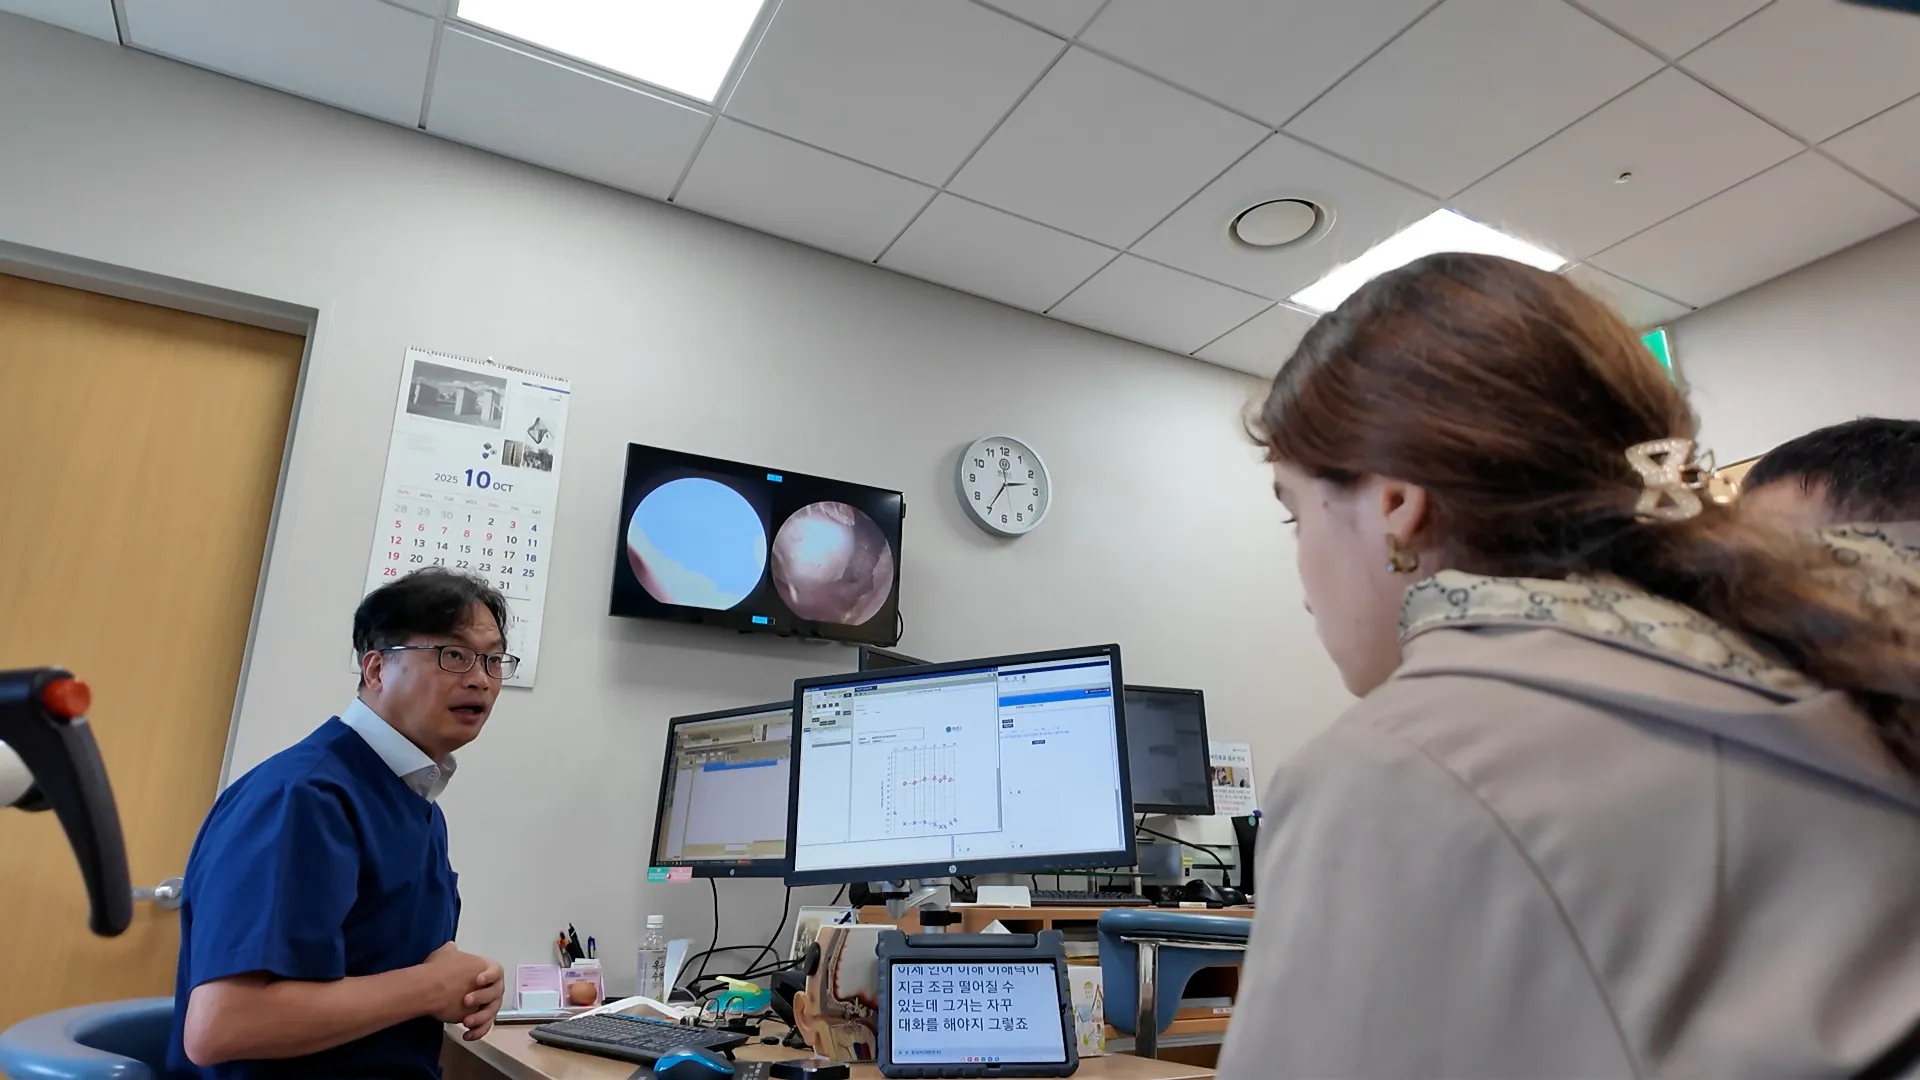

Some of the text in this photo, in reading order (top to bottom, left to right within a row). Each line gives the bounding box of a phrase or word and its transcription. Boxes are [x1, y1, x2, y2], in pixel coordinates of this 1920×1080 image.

[986, 448, 994, 458] 11
[1000, 447, 1010, 456] 12
[974, 458, 984, 468] 10
[1018, 456, 1022, 464] 1
[969, 473, 976, 482] 9
[1028, 470, 1034, 478] 2
[434, 468, 513, 492] 2025 10 OCT
[975, 491, 980, 500] 8
[1032, 488, 1038, 496] 3
[394, 504, 408, 513] 28
[417, 508, 430, 517] 29
[441, 511, 453, 520] 30
[1028, 504, 1034, 512] 4
[1001, 515, 1008, 524] 6
[1016, 513, 1023, 522] 5
[506, 536, 517, 544] 10
[528, 539, 537, 547] 11
[390, 536, 536, 562] 12 13 14 15 16 17 18
[388, 552, 534, 577] 19 20 21 22 23 24 25
[384, 568, 396, 576] 26
[499, 582, 510, 590] 31
[898, 980, 1015, 994] 지금 조금 떨어질 수
[898, 998, 1013, 1012] 있는데 그거는 자꾸
[898, 1017, 1029, 1032] 대화를 해야지 그렇죠
